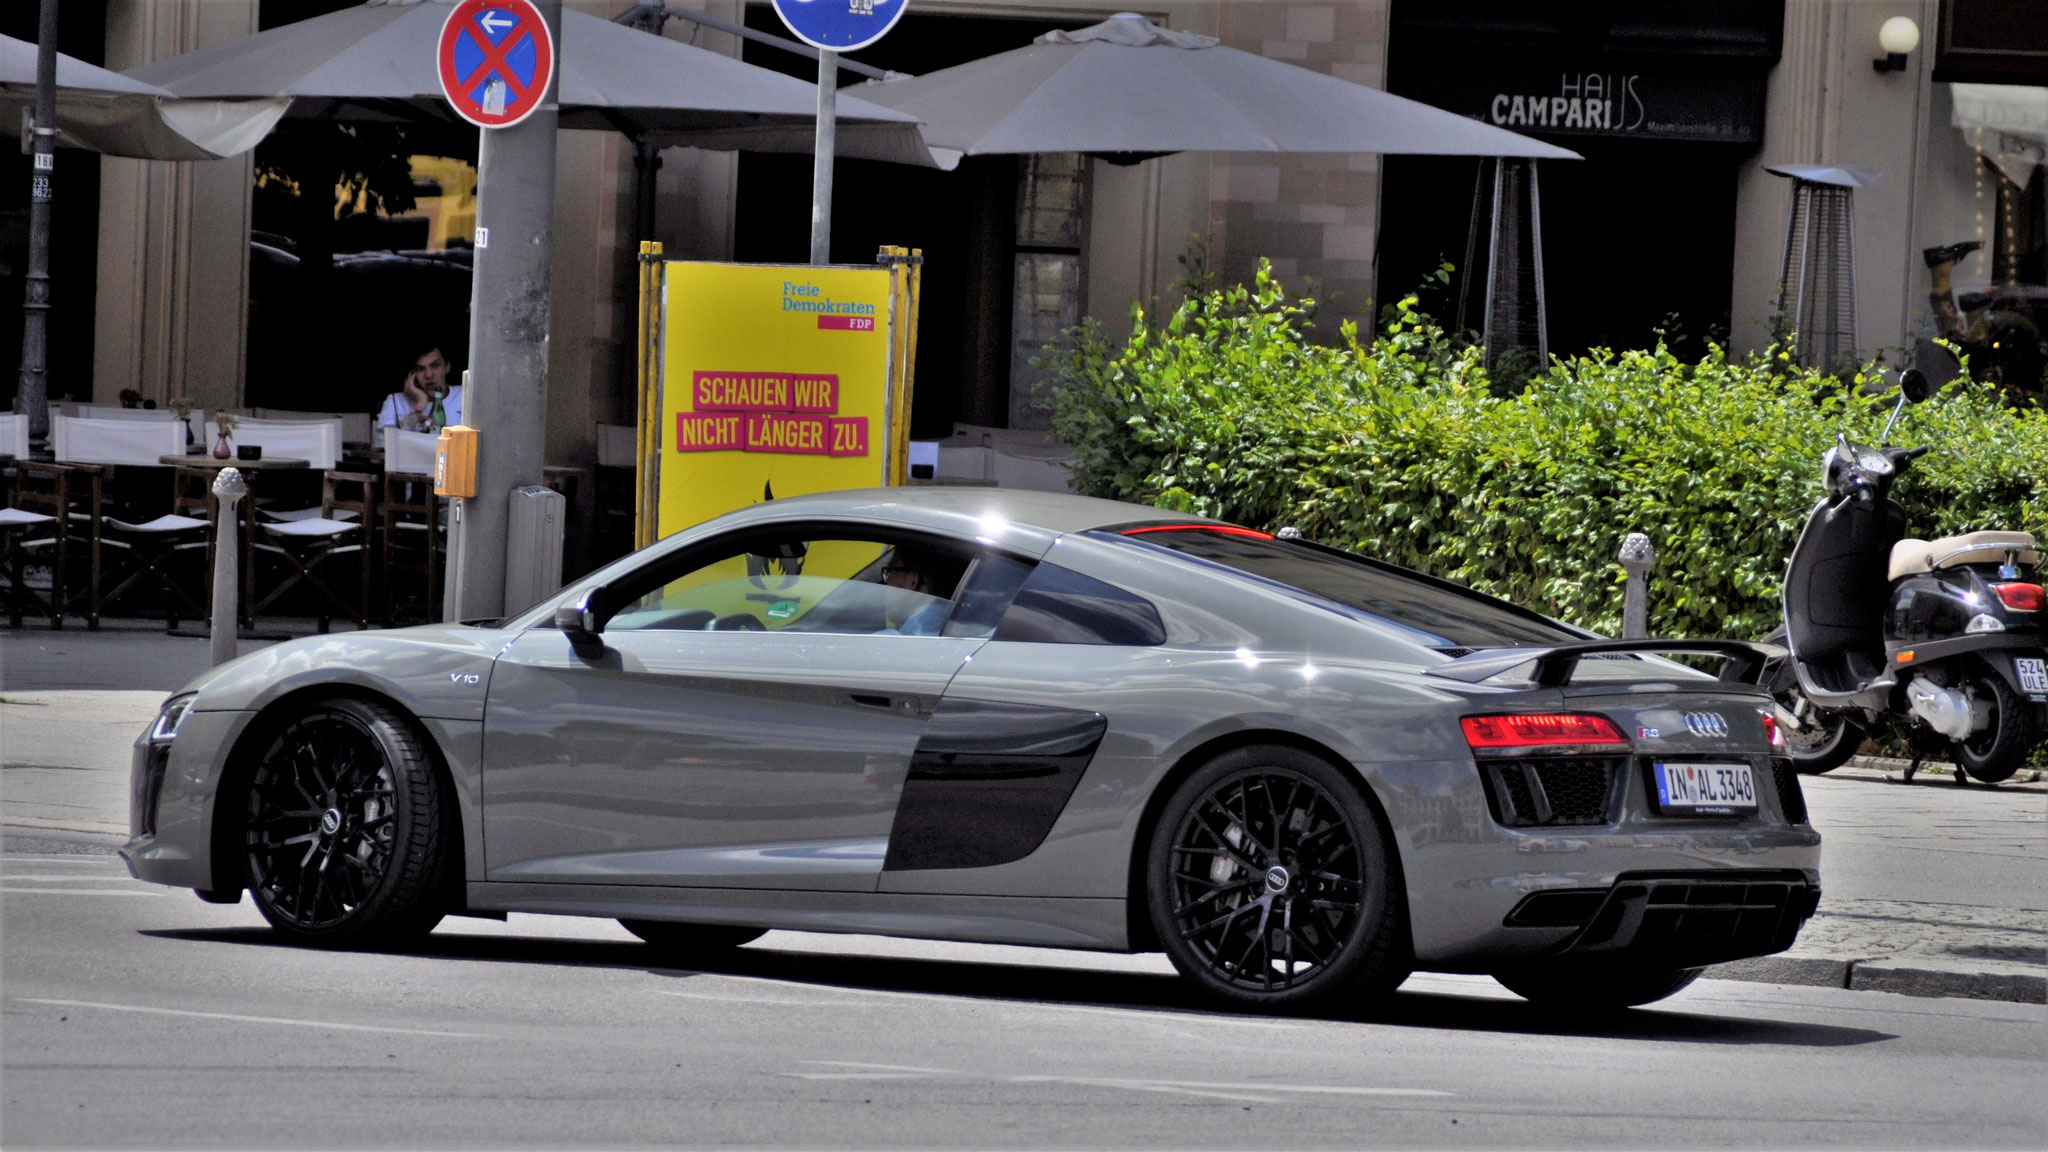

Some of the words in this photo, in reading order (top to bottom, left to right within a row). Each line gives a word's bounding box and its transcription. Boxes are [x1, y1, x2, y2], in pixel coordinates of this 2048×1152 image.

[1561, 72, 1645, 130] HAUS
[1491, 93, 1613, 130] CAMPARI
[783, 281, 820, 297] Freie
[782, 297, 876, 315] Demokraten
[849, 318, 872, 329] FDP
[699, 376, 787, 406] SCHAUEN
[794, 380, 832, 409] WIR
[683, 416, 739, 446] NICHT
[748, 414, 824, 449] LÄNGER
[833, 424, 864, 452] ZU.
[2019, 660, 2044, 674] 524
[450, 673, 479, 684] V10
[2023, 675, 2048, 690] ULE
[1668, 768, 1689, 800] IN
[1697, 768, 1718, 801] AL
[1716, 769, 1753, 802] 3348
